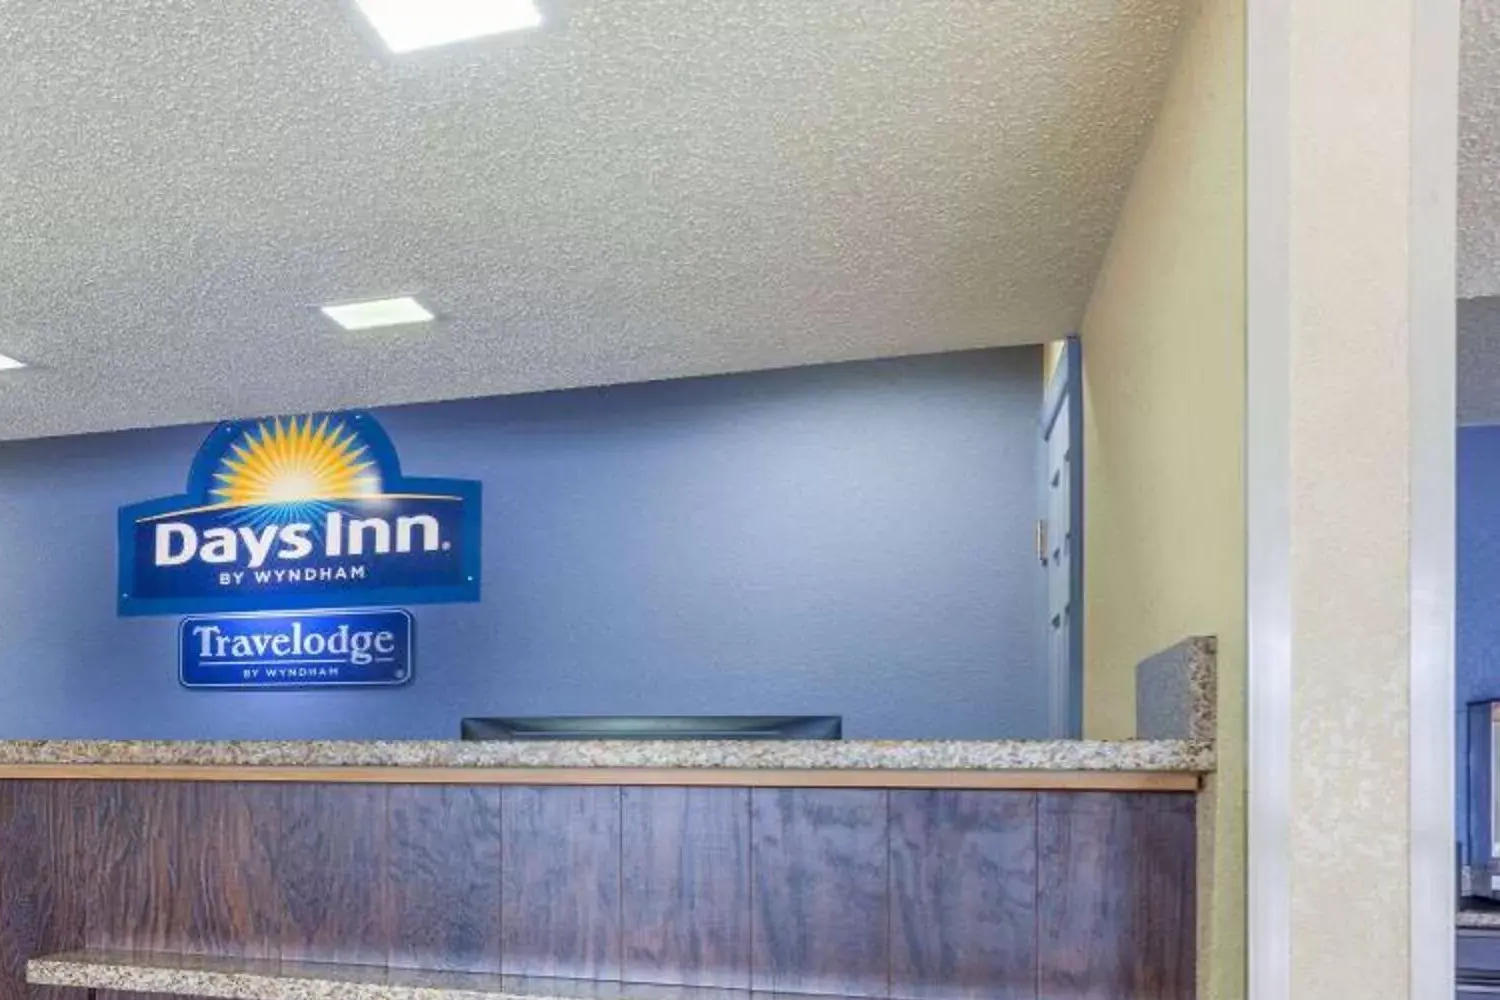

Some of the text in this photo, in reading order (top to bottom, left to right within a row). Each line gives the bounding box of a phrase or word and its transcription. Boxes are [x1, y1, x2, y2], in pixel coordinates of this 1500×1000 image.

[155, 511, 439, 568] Days Inn
[219, 565, 366, 586] BY WYNDHAM
[192, 621, 395, 665] Travelodge
[243, 667, 339, 679] BY WYNDHAM
